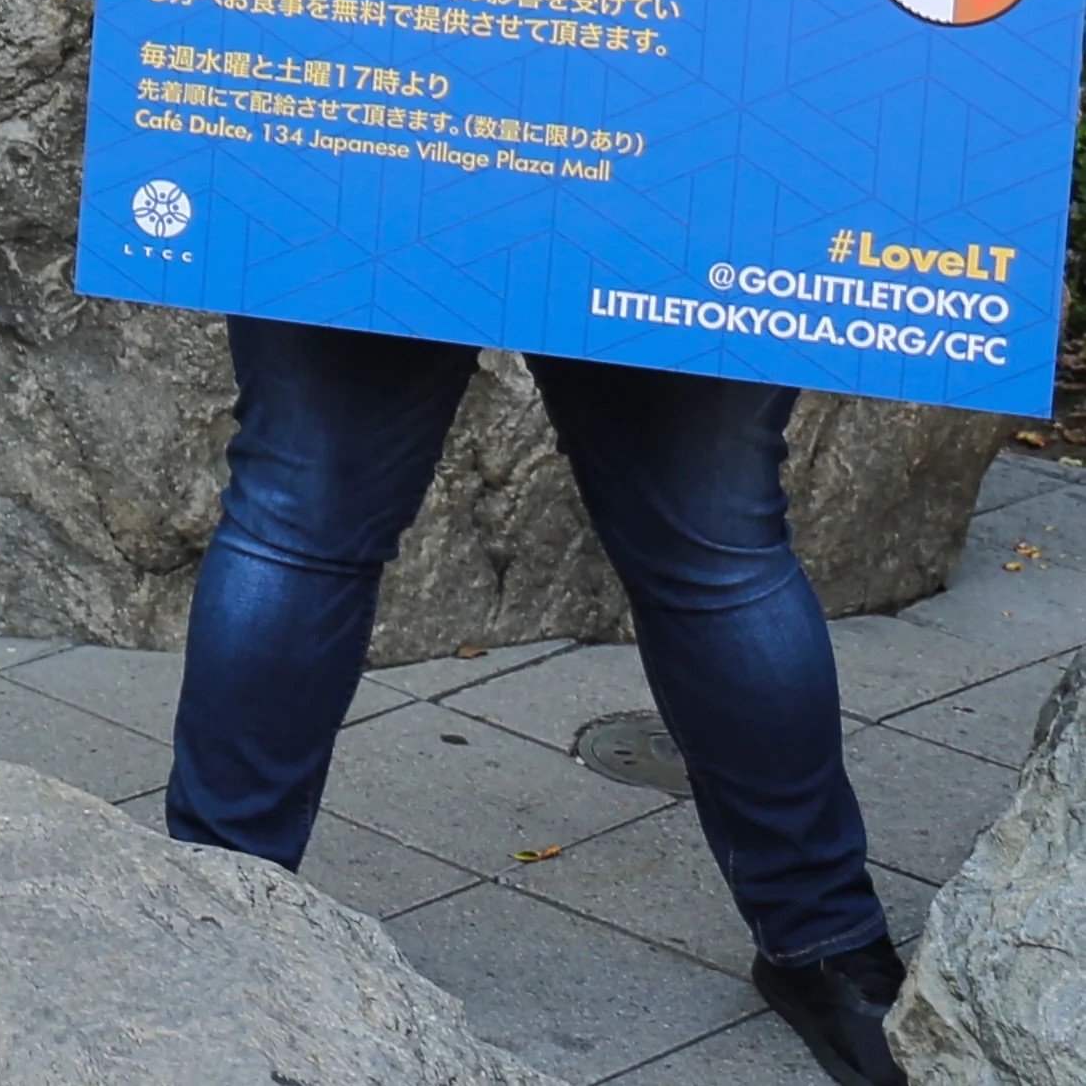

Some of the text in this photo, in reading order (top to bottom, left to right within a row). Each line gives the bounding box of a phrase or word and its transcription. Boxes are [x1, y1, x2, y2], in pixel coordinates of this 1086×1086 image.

[139, 41, 450, 99] 毎週水曜と土曜17時より
[134, 109, 611, 182] Café Dulce, 134 Japanese Village Plaza Mall
[828, 229, 1016, 282] #LoveLT
[708, 262, 1009, 325] @GOLITTLETOKYO
[591, 288, 1008, 365] LITTLETOKYOLA.ORG/CFC
